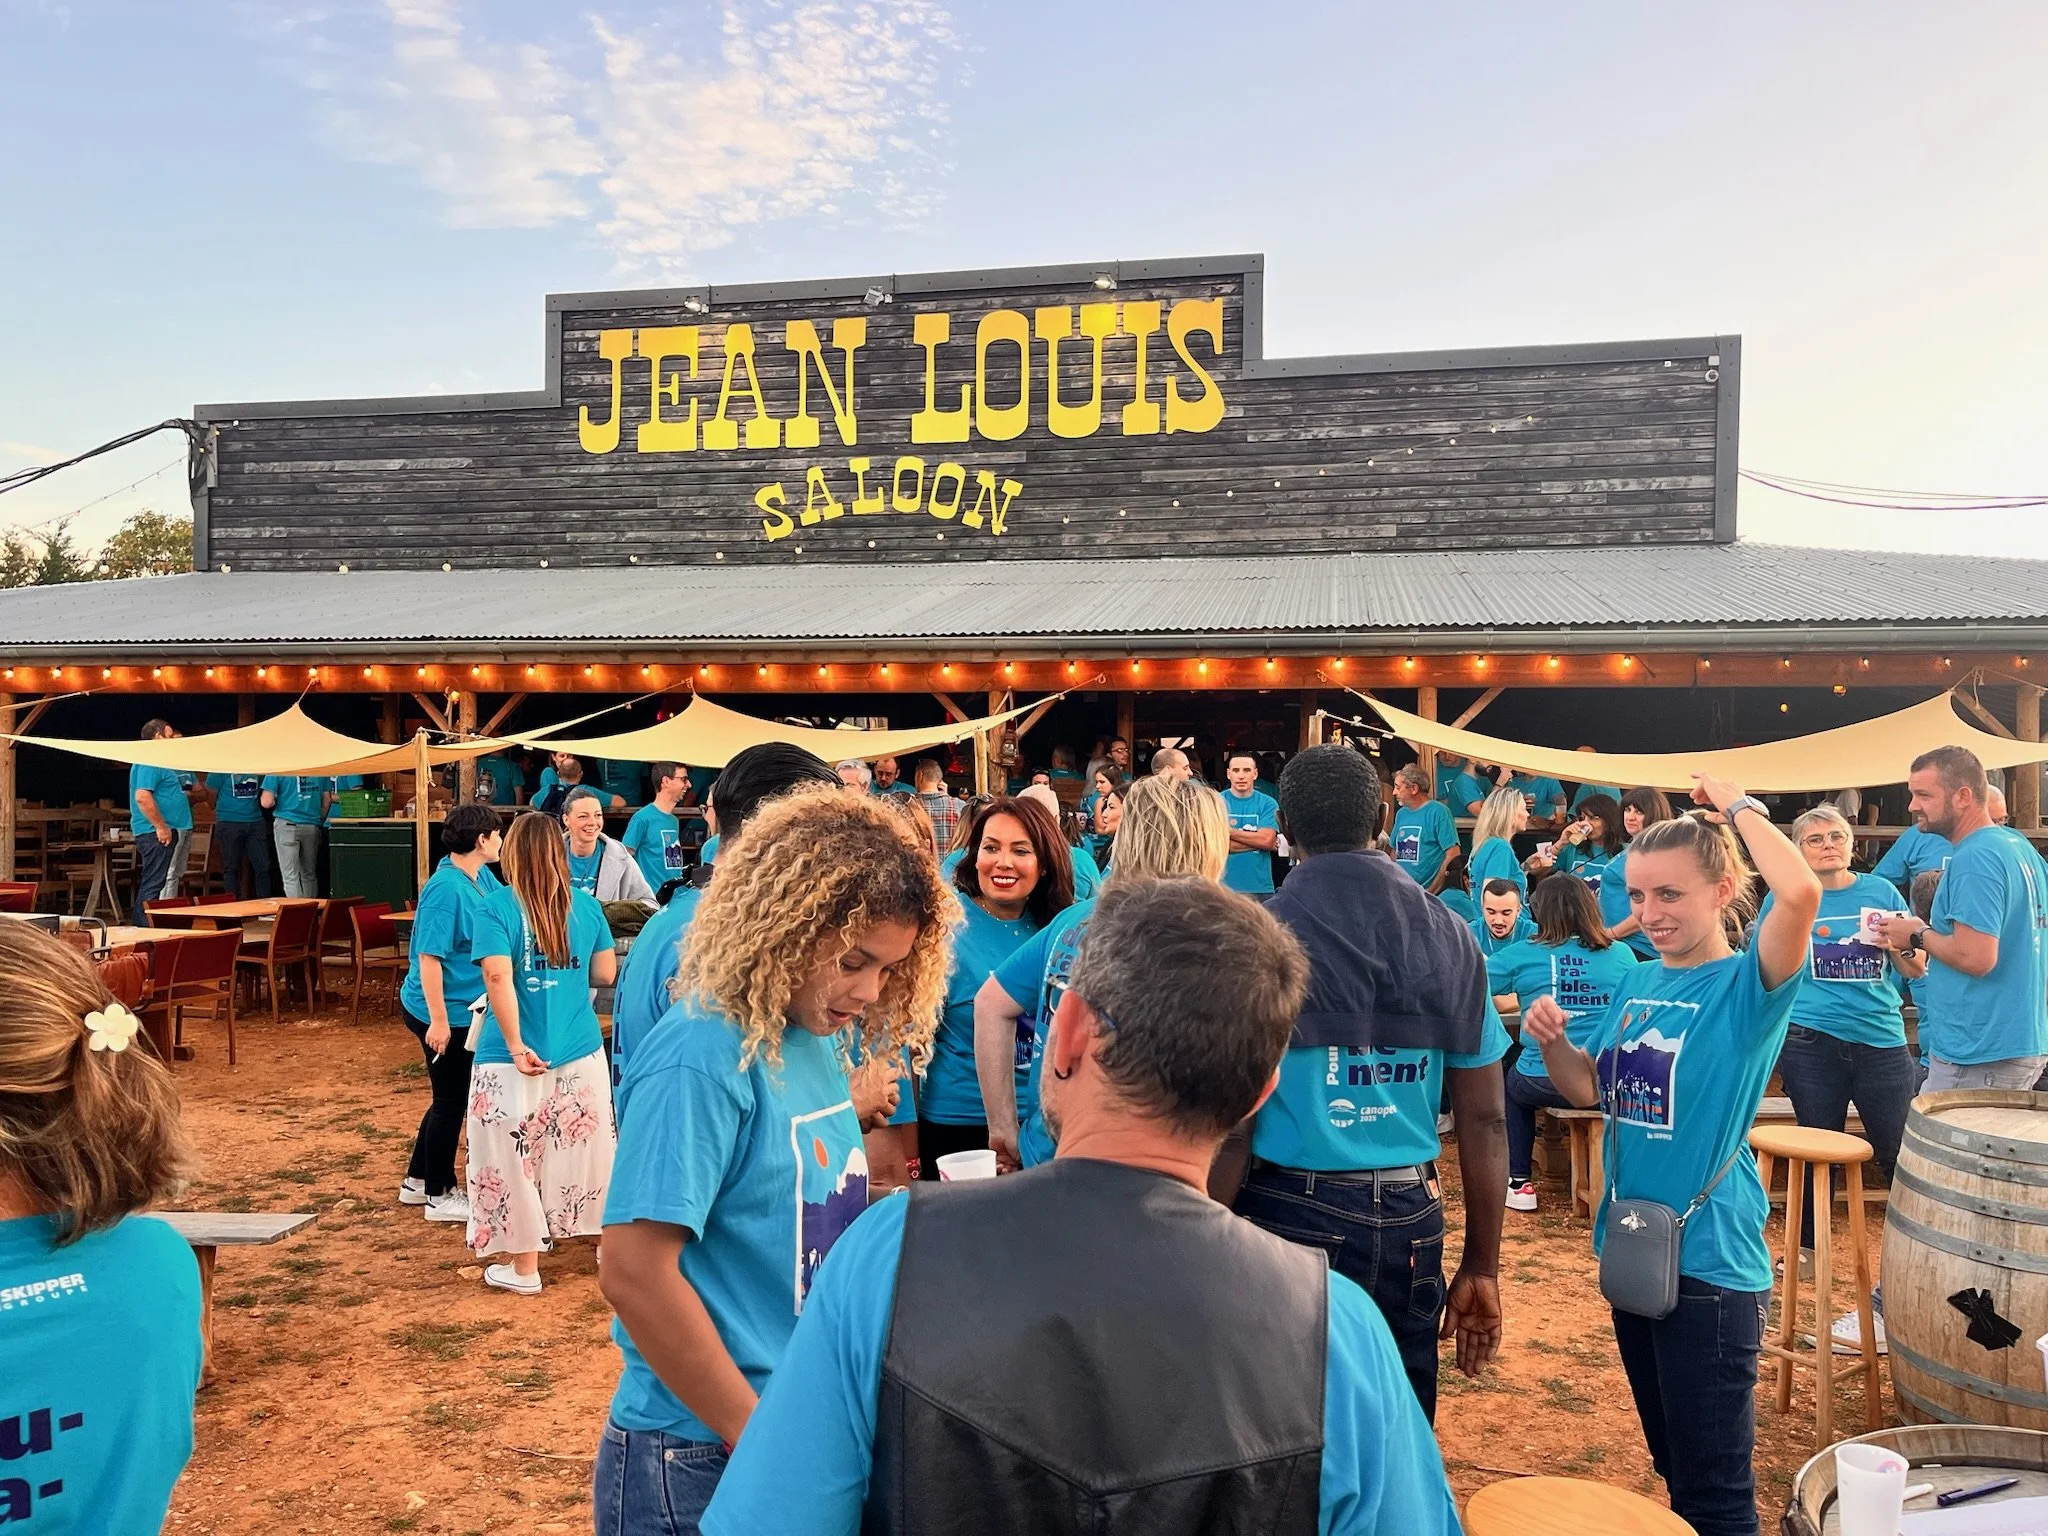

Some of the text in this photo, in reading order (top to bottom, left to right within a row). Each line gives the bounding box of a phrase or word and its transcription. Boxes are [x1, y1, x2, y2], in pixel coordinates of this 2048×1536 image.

[578, 297, 1225, 455] JEAN LOUIS
[754, 456, 1023, 542] SALOON
[1560, 954, 1590, 966] du-
[1560, 967, 1587, 977] ra-
[1561, 979, 1597, 993] ble-
[1560, 993, 1610, 1006] ment
[0, 1273, 85, 1303] SKIPPER
[3, 1285, 89, 1310] GROUPE
